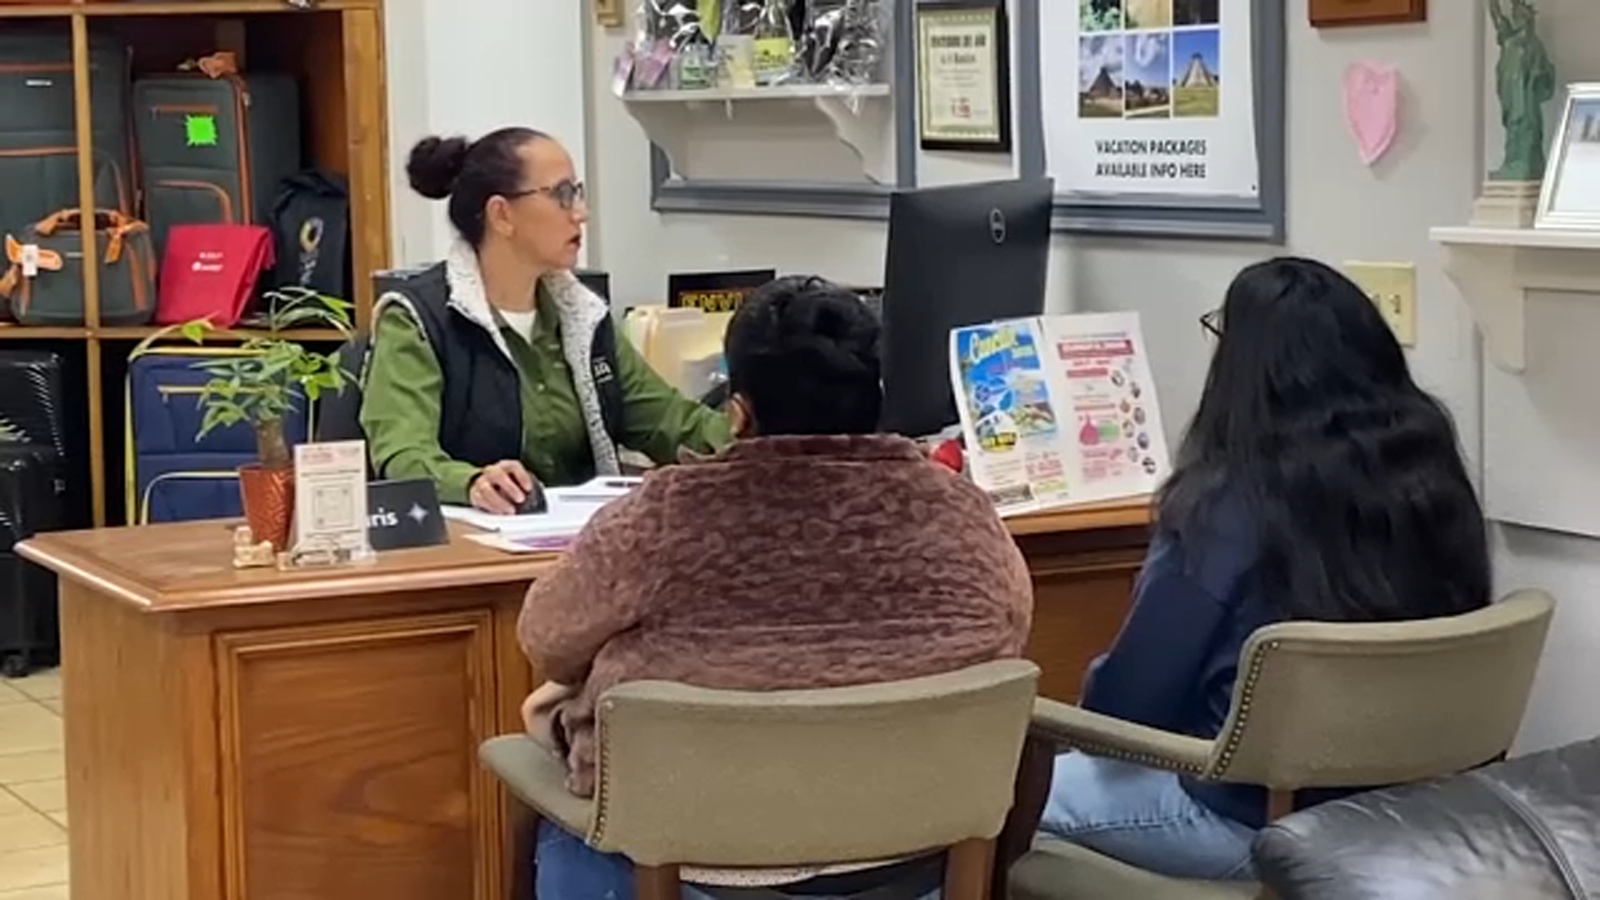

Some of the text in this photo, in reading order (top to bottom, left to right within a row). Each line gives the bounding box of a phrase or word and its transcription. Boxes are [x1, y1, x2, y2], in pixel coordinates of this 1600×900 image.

[1095, 139, 1206, 155] VACATION PACKAGES
[1096, 163, 1206, 178] AVAILABLE INFO HERE
[367, 507, 399, 527] ris
